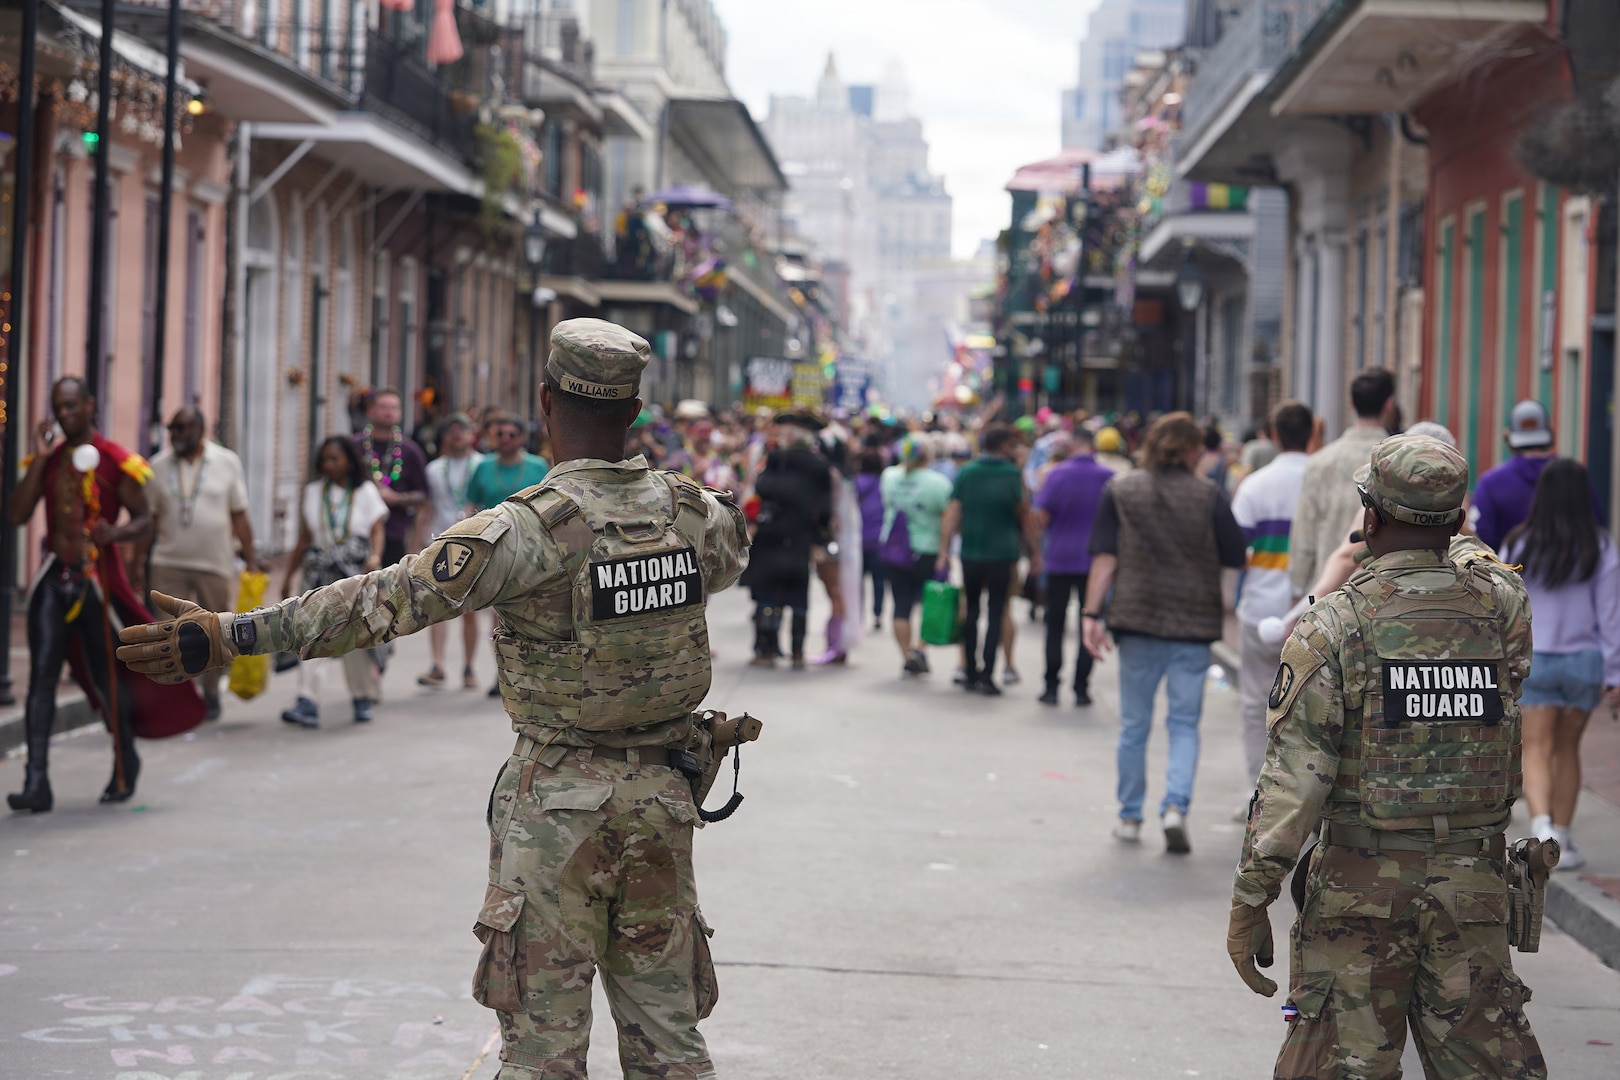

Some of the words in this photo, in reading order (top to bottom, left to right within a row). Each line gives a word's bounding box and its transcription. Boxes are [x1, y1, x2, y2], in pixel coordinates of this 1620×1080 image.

[568, 381, 619, 397] WILLIAMS
[1412, 513, 1449, 524] TONEY
[597, 551, 697, 589] NATIONAL
[614, 581, 687, 614] GUARD
[1389, 666, 1498, 690] NATIONAL
[1405, 693, 1485, 718] GUARD
[62, 995, 388, 1017] GRACE
[21, 1020, 363, 1045] CHUCK
